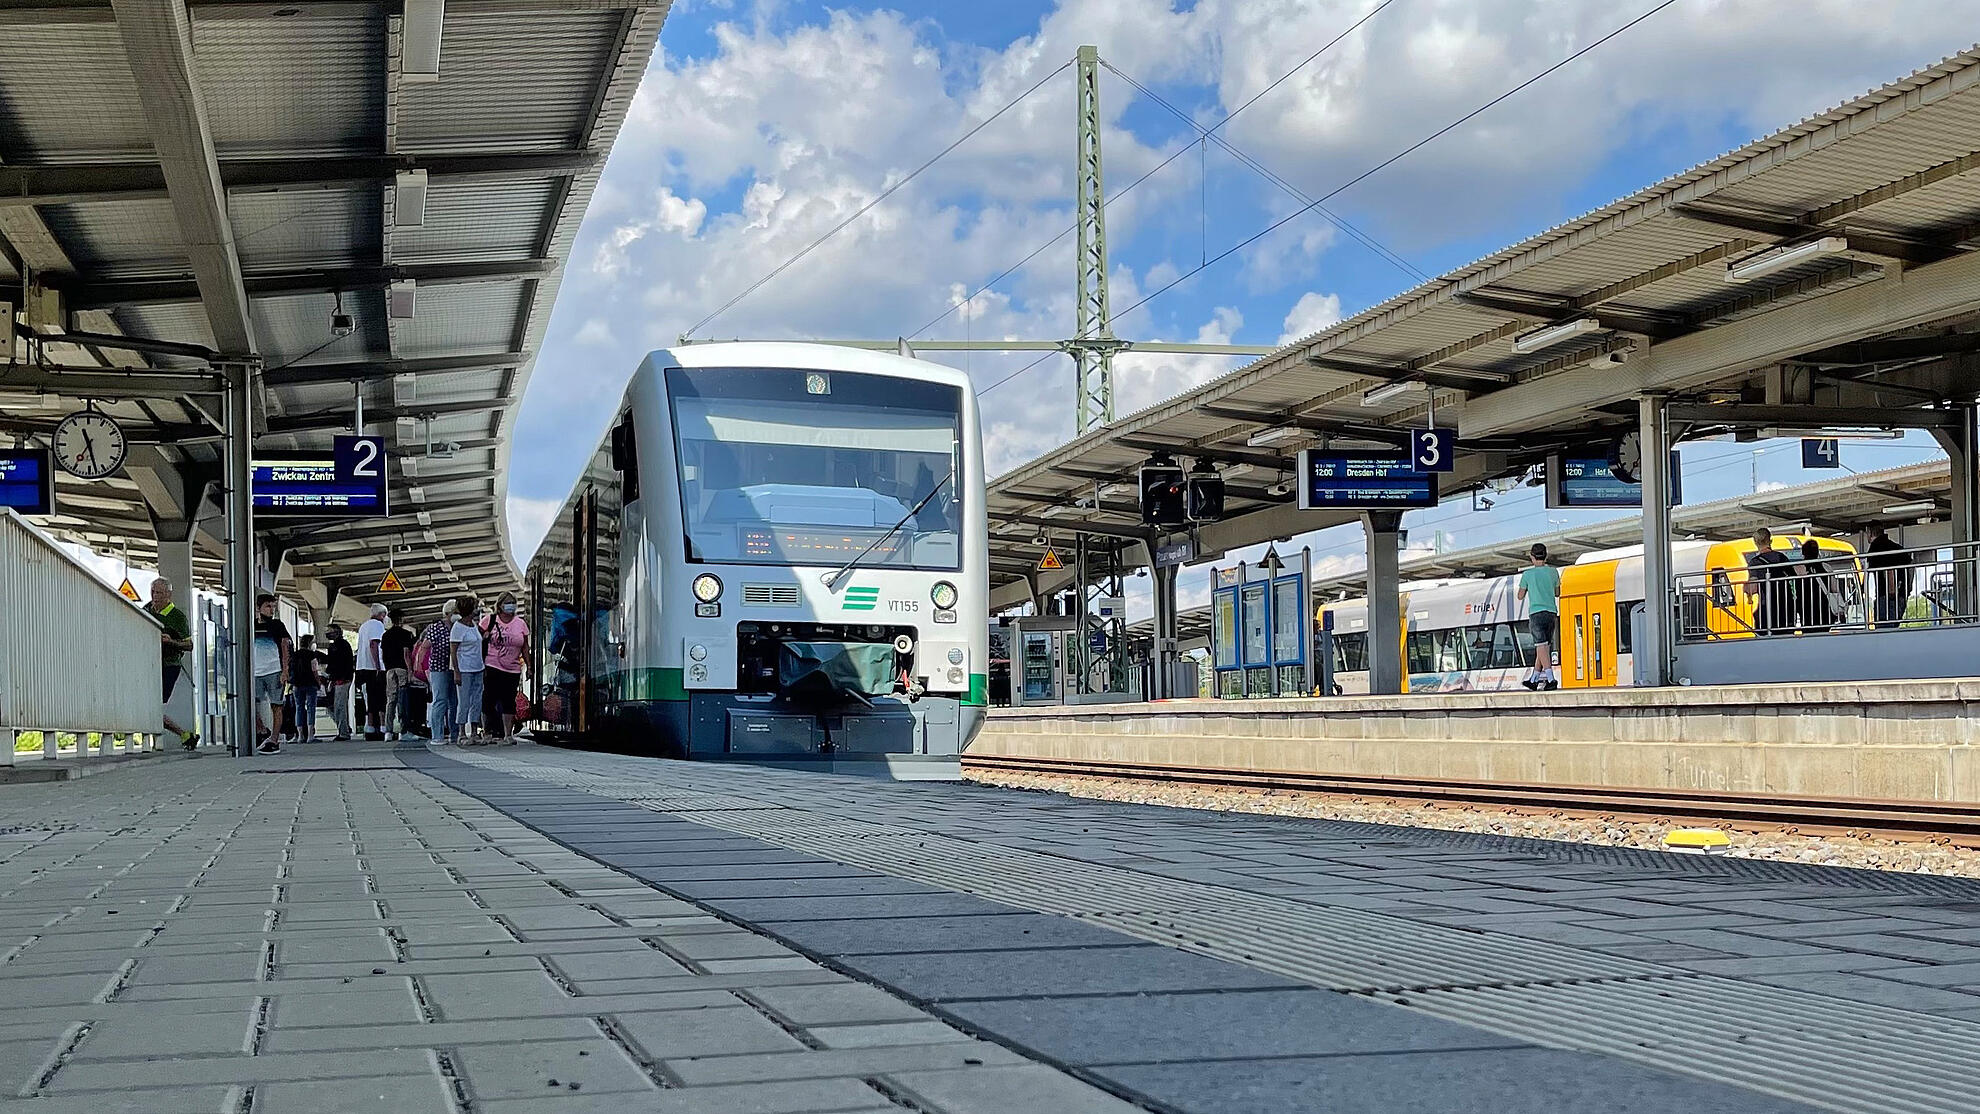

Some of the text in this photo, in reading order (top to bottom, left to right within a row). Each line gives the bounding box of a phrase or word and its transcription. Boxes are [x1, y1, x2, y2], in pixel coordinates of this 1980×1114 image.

[1420, 433, 1440, 466] 3
[1817, 440, 1834, 461] 4
[353, 440, 378, 476] 2
[272, 471, 307, 481] Zwickau
[1314, 468, 1333, 477] 12:00
[1346, 469, 1387, 477] Dresden Hbf
[888, 600, 919, 612] VT155
[1473, 602, 1495, 614] trilex
